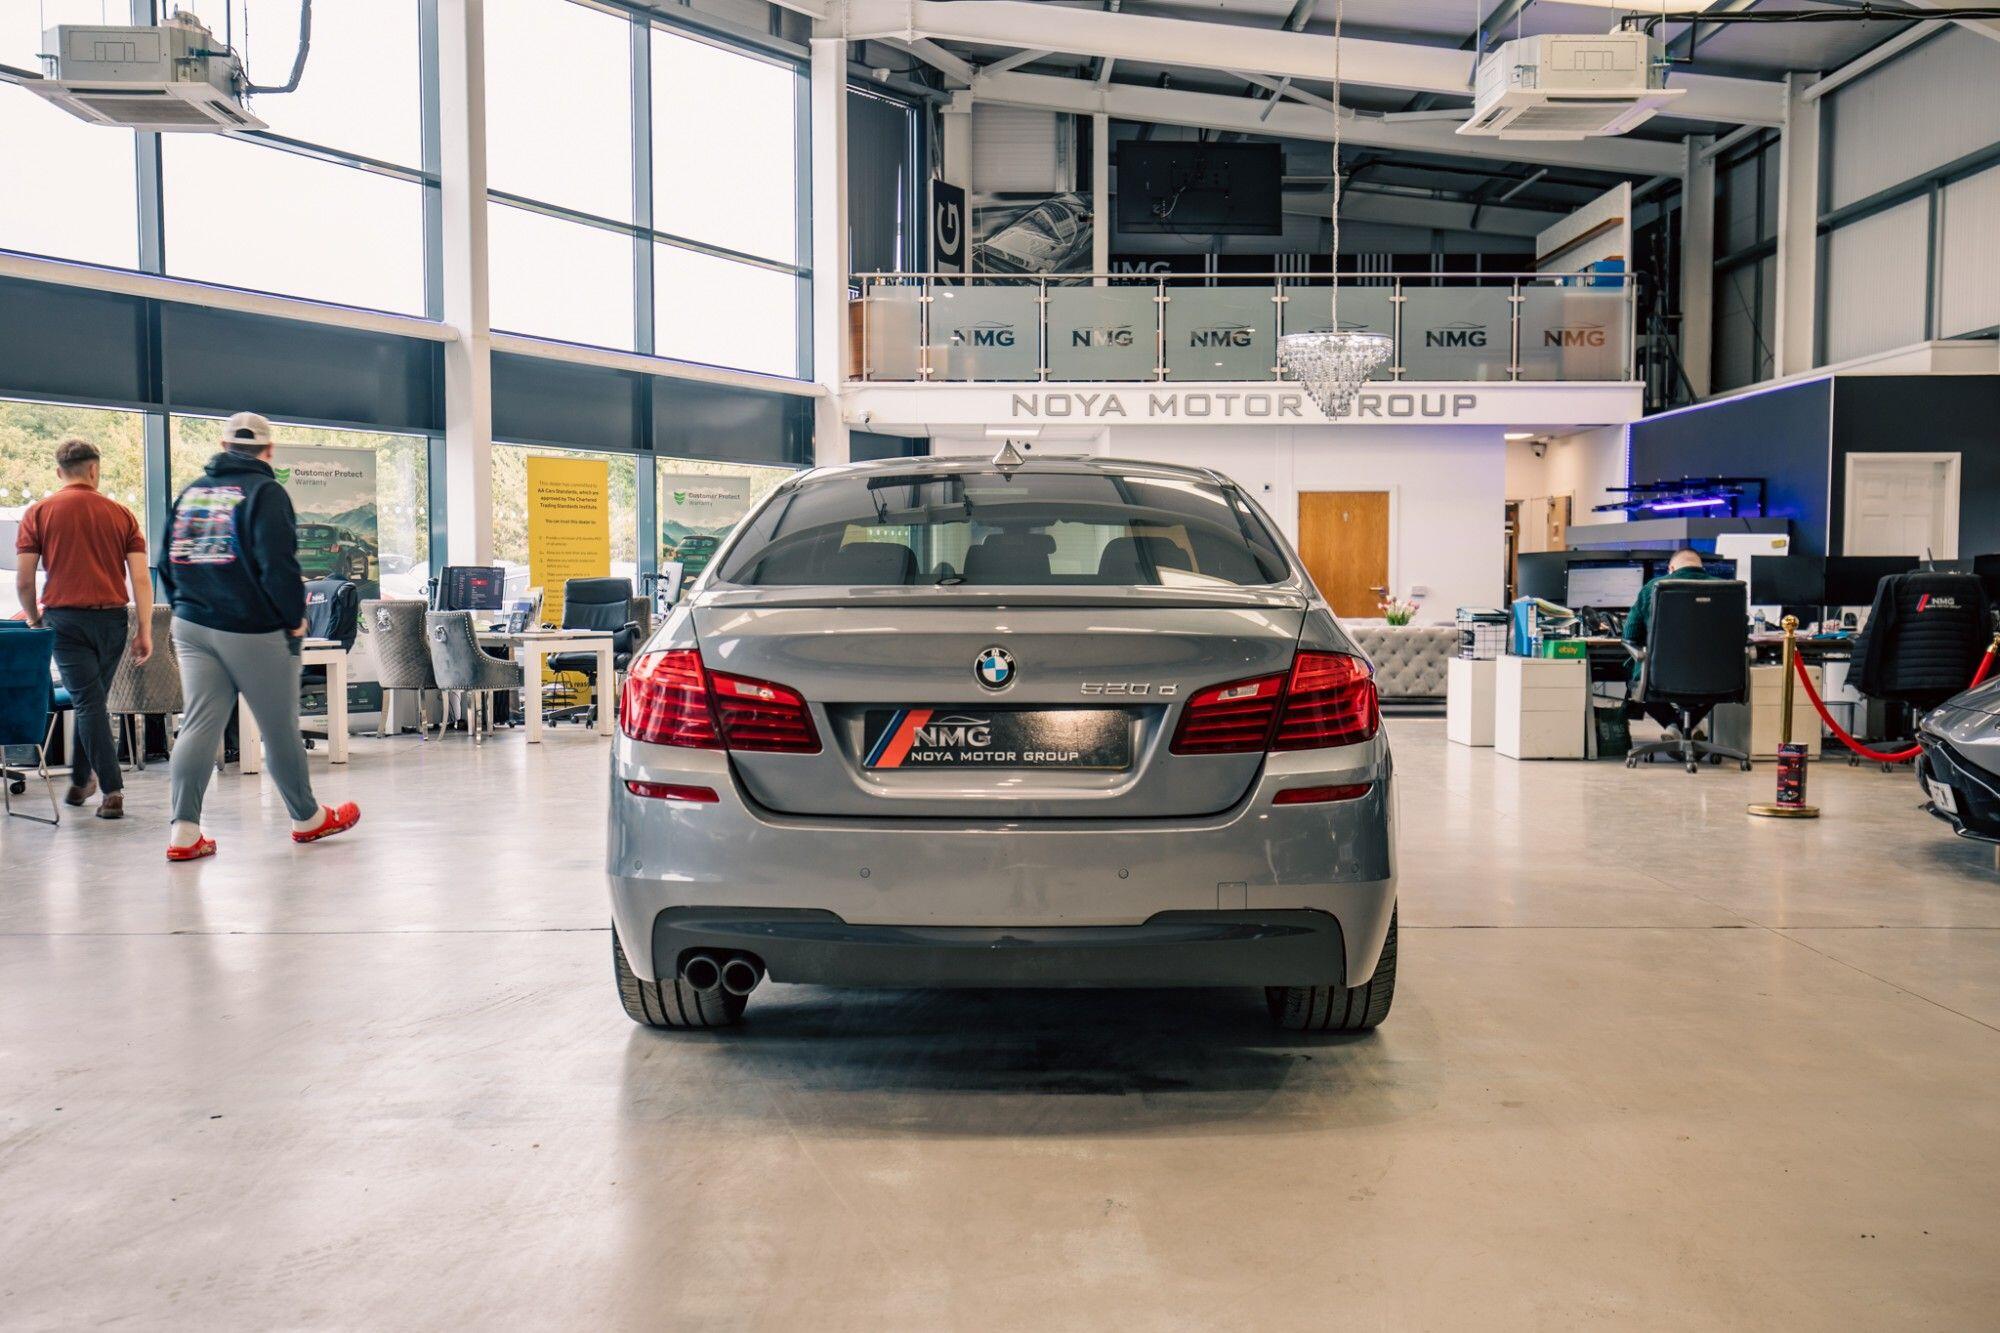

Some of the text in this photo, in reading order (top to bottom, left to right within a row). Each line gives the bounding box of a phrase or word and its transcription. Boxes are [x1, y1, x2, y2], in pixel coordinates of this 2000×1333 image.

[953, 329, 1015, 347] NMG
[1072, 329, 1133, 347] NMG
[1190, 329, 1251, 347] NMG
[1426, 330, 1487, 347] NMG
[1544, 330, 1606, 347] NMG
[1012, 393, 1127, 417] NOYA
[1148, 393, 1303, 417] MOTOR
[294, 468, 363, 478] Customer Protect
[296, 479, 327, 487] Warranty
[688, 492, 717, 500] Customer
[979, 648, 1014, 663] BMW
[1080, 682, 1180, 695] 520 d
[914, 726, 992, 748] NMG
[911, 751, 1079, 762] NOYA MOTOR GROUP
